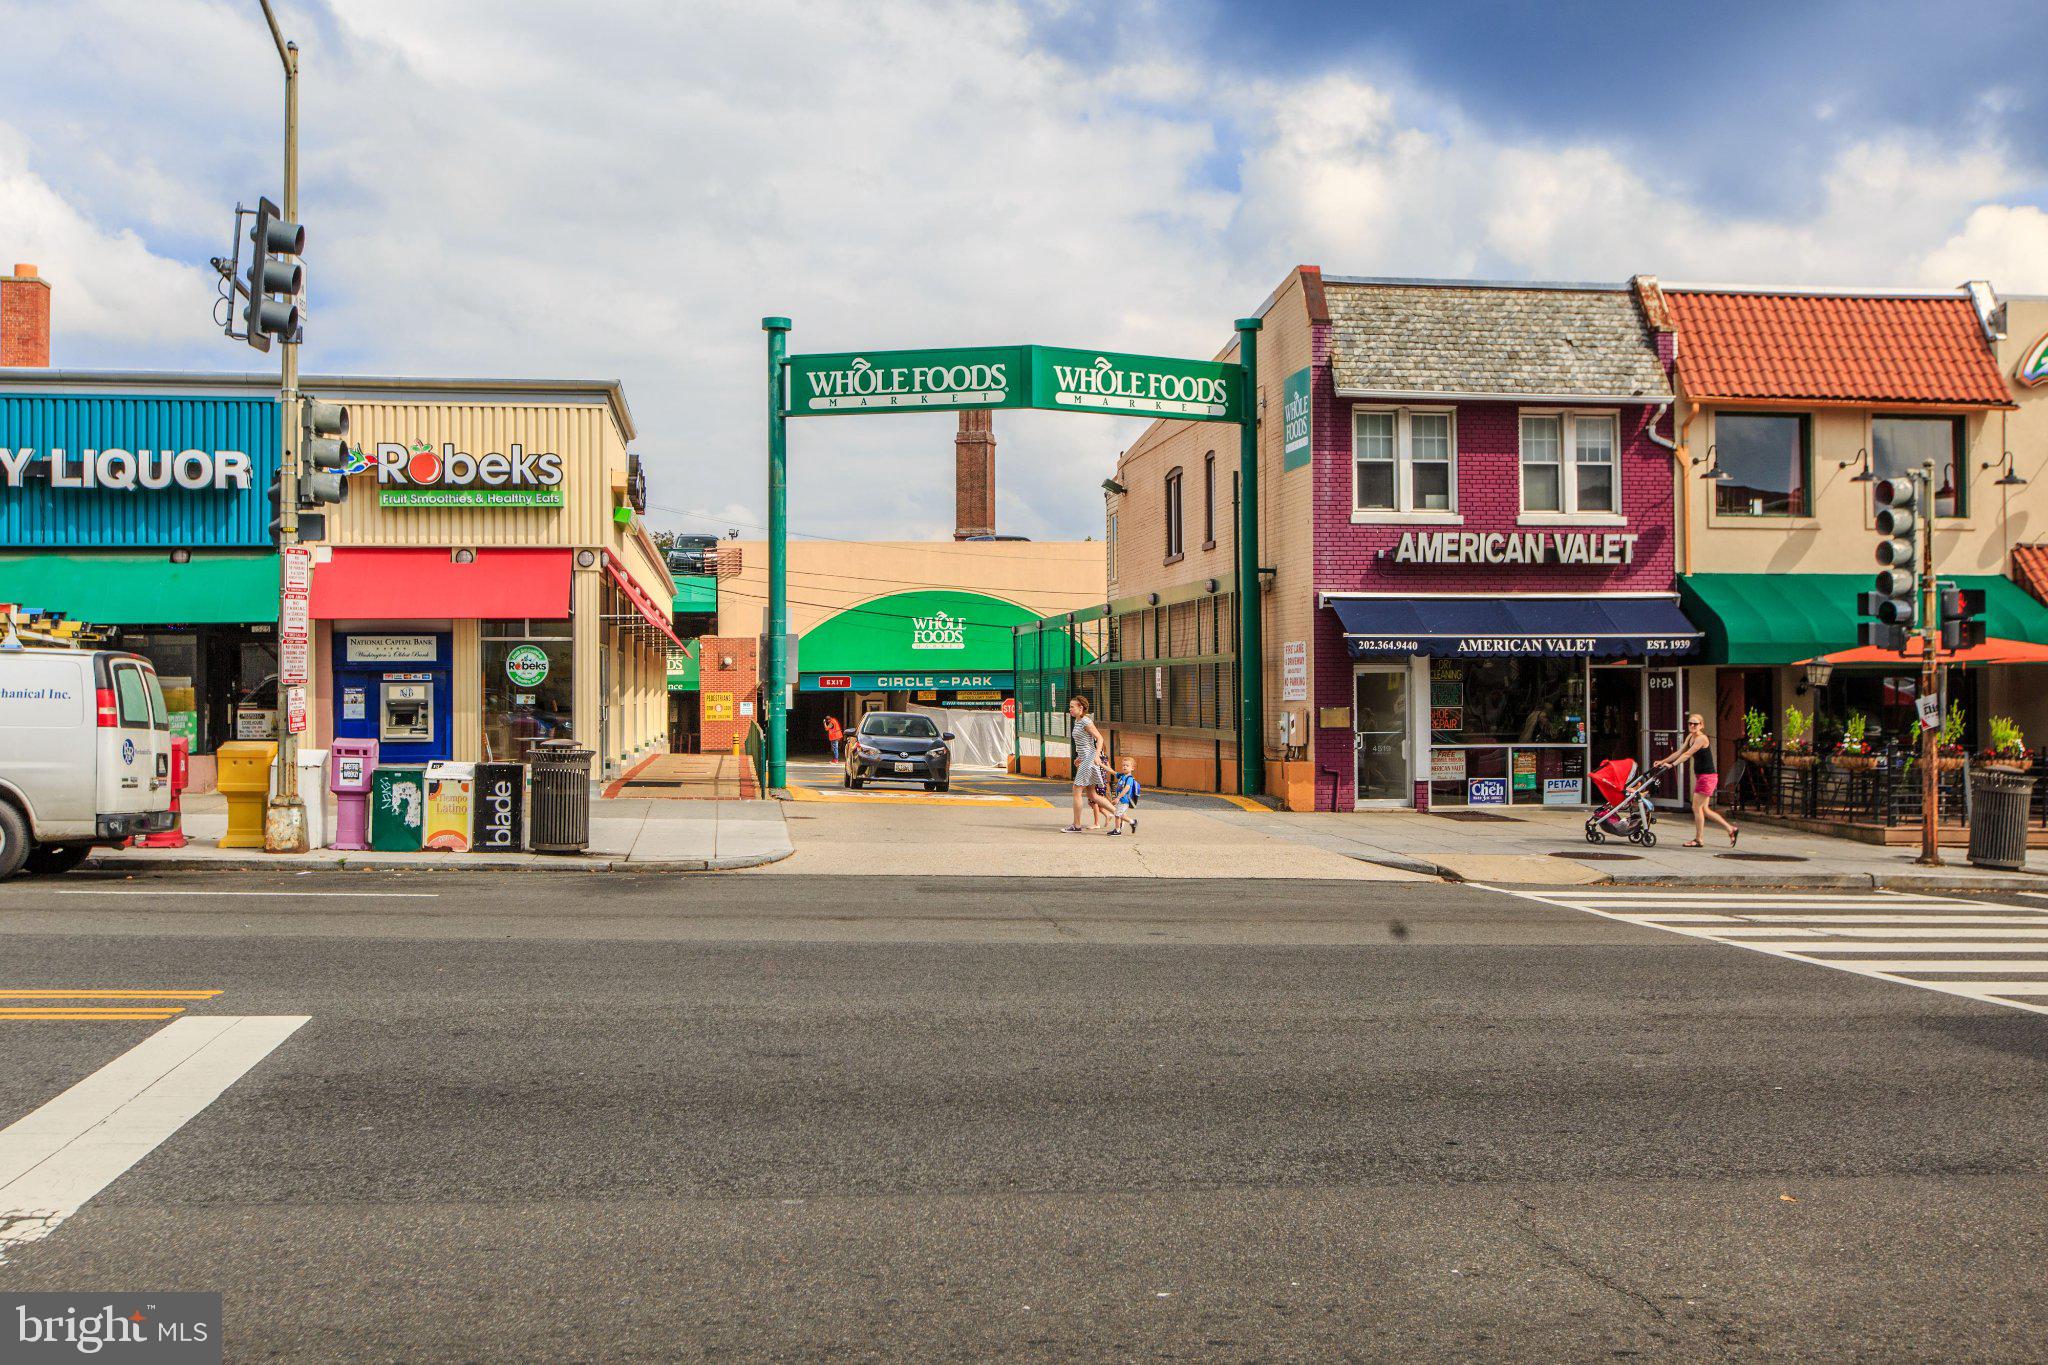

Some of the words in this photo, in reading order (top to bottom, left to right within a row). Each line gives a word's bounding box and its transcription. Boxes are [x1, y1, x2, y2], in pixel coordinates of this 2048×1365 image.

[807, 358, 910, 396] WHOLE
[912, 363, 1007, 392] FOODS
[1053, 356, 1145, 397] WHOLE
[1148, 373, 1228, 404] FOODS
[829, 393, 989, 407] MARKET
[1074, 395, 1213, 414] MARKET
[1285, 391, 1309, 422] WHOLE
[1286, 415, 1308, 442] FOODS
[51, 448, 252, 491] LIQUOR
[382, 494, 407, 504] Fruit
[411, 493, 472, 504] Smoothies
[475, 494, 484, 504] &
[487, 493, 533, 506] Healthy
[536, 493, 560, 504] Eats
[1395, 532, 1545, 564] AMERICAN
[1554, 533, 1638, 564] VALET
[911, 611, 967, 630] WHOLE
[350, 638, 384, 646] NATIONAL
[385, 638, 412, 646] CAPITAL
[413, 638, 433, 646] BANK
[913, 629, 964, 643] FOODS
[1358, 640, 1418, 651] 202.364.9440
[1457, 639, 1543, 652] AMERICAN
[1546, 638, 1597, 652] VALET
[1647, 640, 1669, 650] EST.
[1671, 640, 1691, 650] 1939
[877, 676, 934, 687] CIRCLE
[951, 676, 993, 686] PARK
[49, 688, 72, 700] Inc.
[1003, 705, 1015, 713] STO
[1471, 783, 1504, 796] Cheh
[1547, 779, 1578, 789] PETAR
[441, 793, 468, 804] Tiempo
[436, 803, 468, 814] Latino
[486, 780, 512, 847] blade
